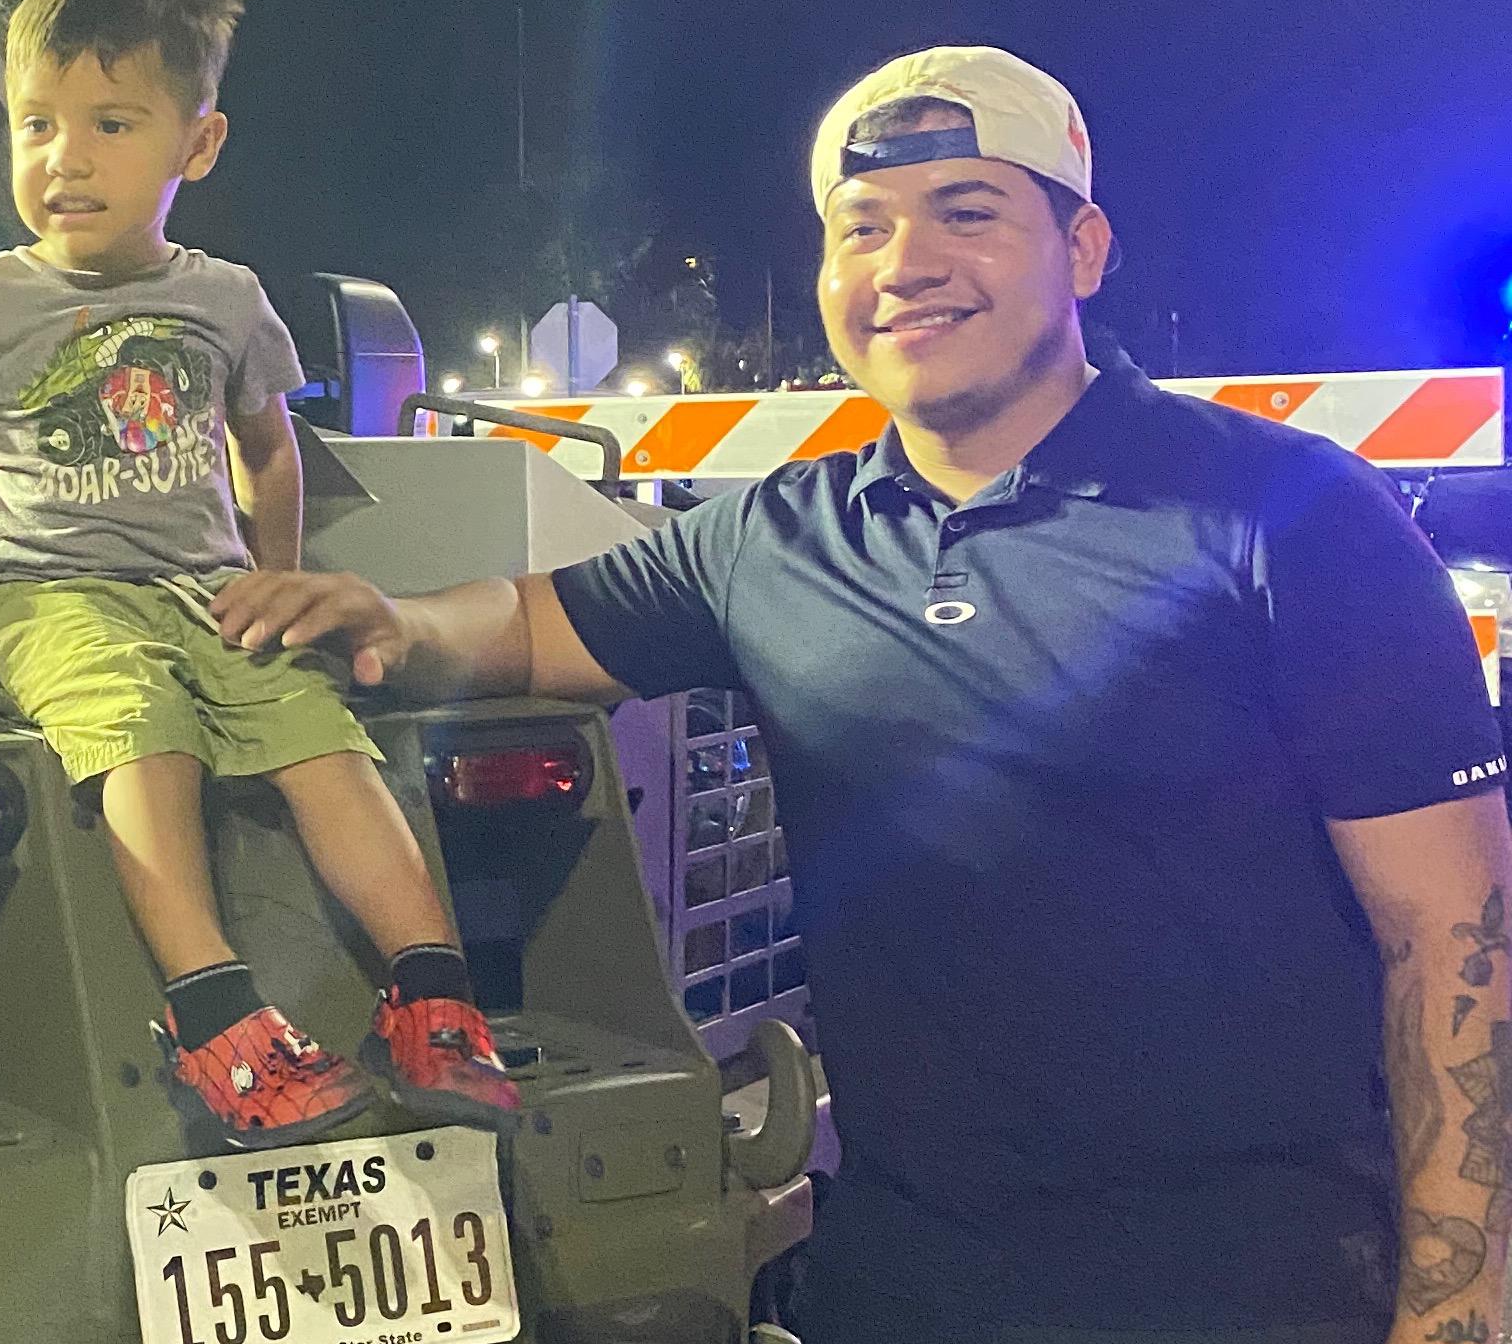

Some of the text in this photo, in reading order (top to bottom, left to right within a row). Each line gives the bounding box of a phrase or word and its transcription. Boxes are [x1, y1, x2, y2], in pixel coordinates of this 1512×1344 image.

[247, 1155, 387, 1210] TEXAS
[277, 1201, 362, 1230] EXEMPT
[325, 1211, 494, 1328] 5013
